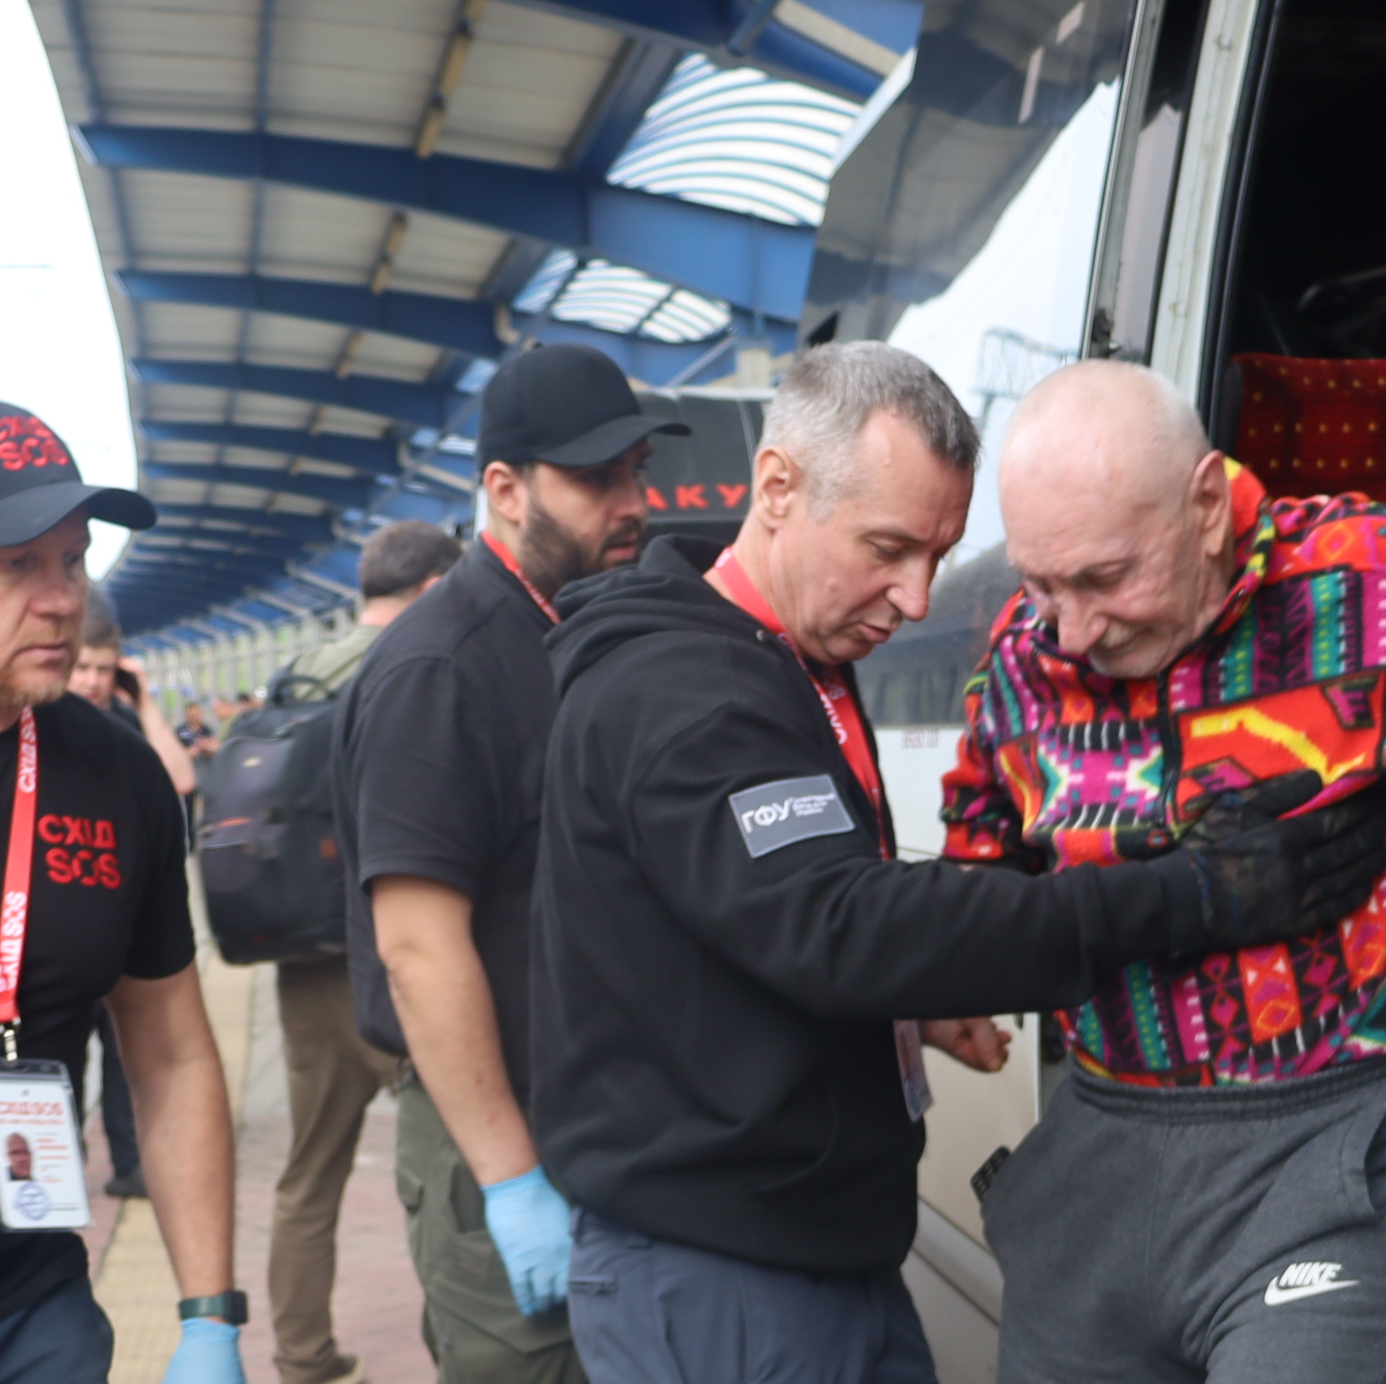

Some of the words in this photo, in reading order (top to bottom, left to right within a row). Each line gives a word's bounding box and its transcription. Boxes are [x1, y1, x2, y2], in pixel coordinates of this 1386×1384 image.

[45, 847, 122, 889] SOS
[4, 891, 27, 937] SOS
[1279, 1261, 1342, 1287] NIKE
